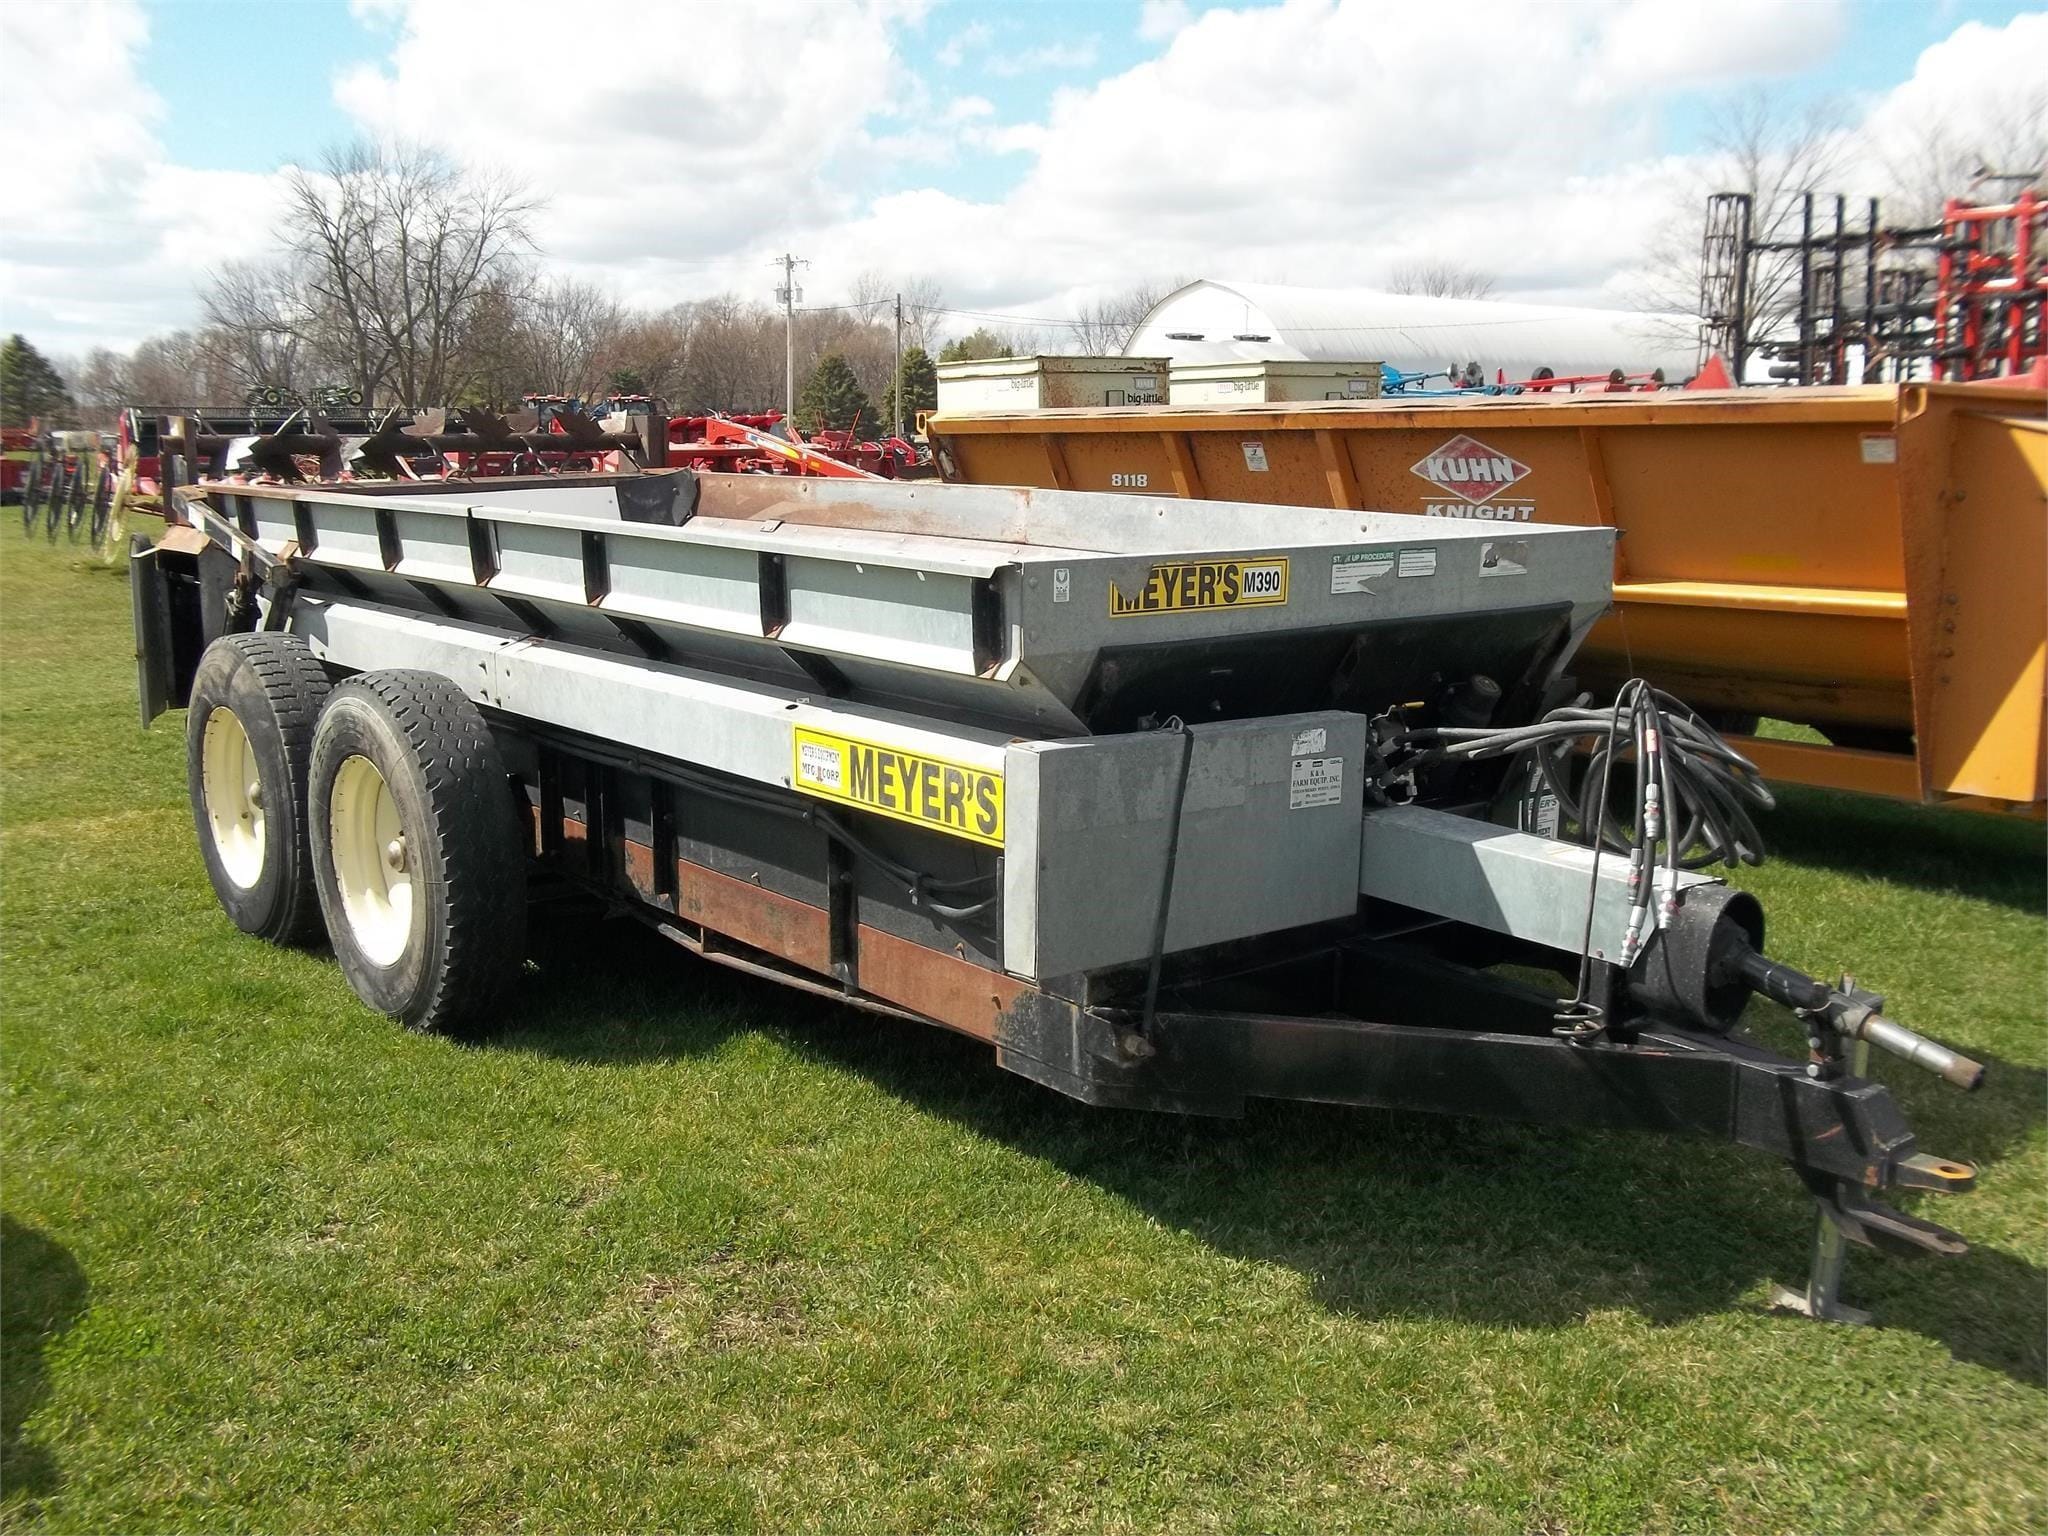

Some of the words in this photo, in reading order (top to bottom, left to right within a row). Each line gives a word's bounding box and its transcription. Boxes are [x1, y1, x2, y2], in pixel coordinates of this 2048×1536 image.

[1127, 392, 1164, 406] big-little
[1426, 457, 1516, 482] KUHN
[1111, 473, 1148, 487] 8118
[1425, 504, 1535, 521] KNIGHT
[1243, 570, 1281, 593] M390
[850, 745, 998, 836] MEYER'S
